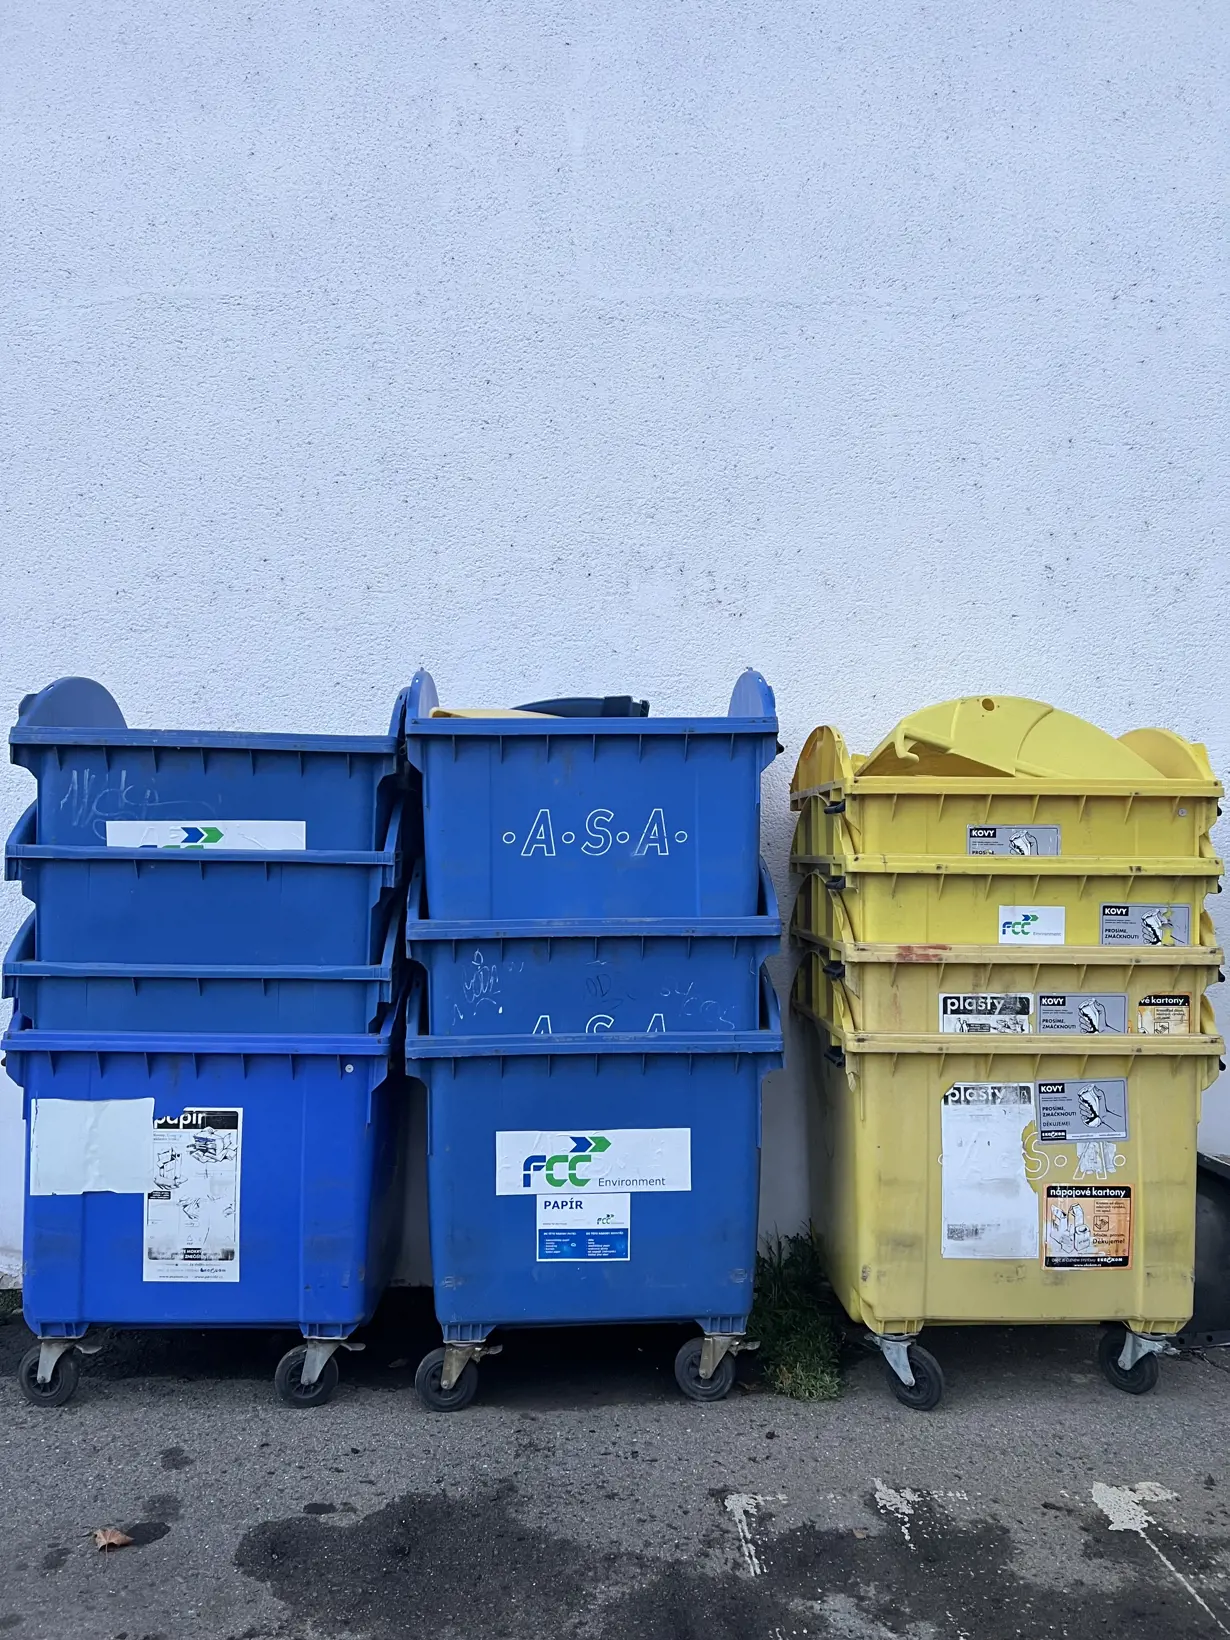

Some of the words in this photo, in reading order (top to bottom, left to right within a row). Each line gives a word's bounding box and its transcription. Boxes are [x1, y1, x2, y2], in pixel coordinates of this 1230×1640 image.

[1002, 921, 1031, 935] FCC
[946, 994, 1005, 1014] plasty
[1042, 997, 1064, 1005] KOVY
[1151, 996, 1184, 1006] kartony
[946, 1086, 1006, 1104] plasty
[522, 1155, 592, 1188] FCC
[598, 1177, 666, 1187] Environment
[1050, 1187, 1091, 1198] nápojové
[1092, 1186, 1126, 1198] kartony
[544, 1197, 583, 1209] PAPÍR
